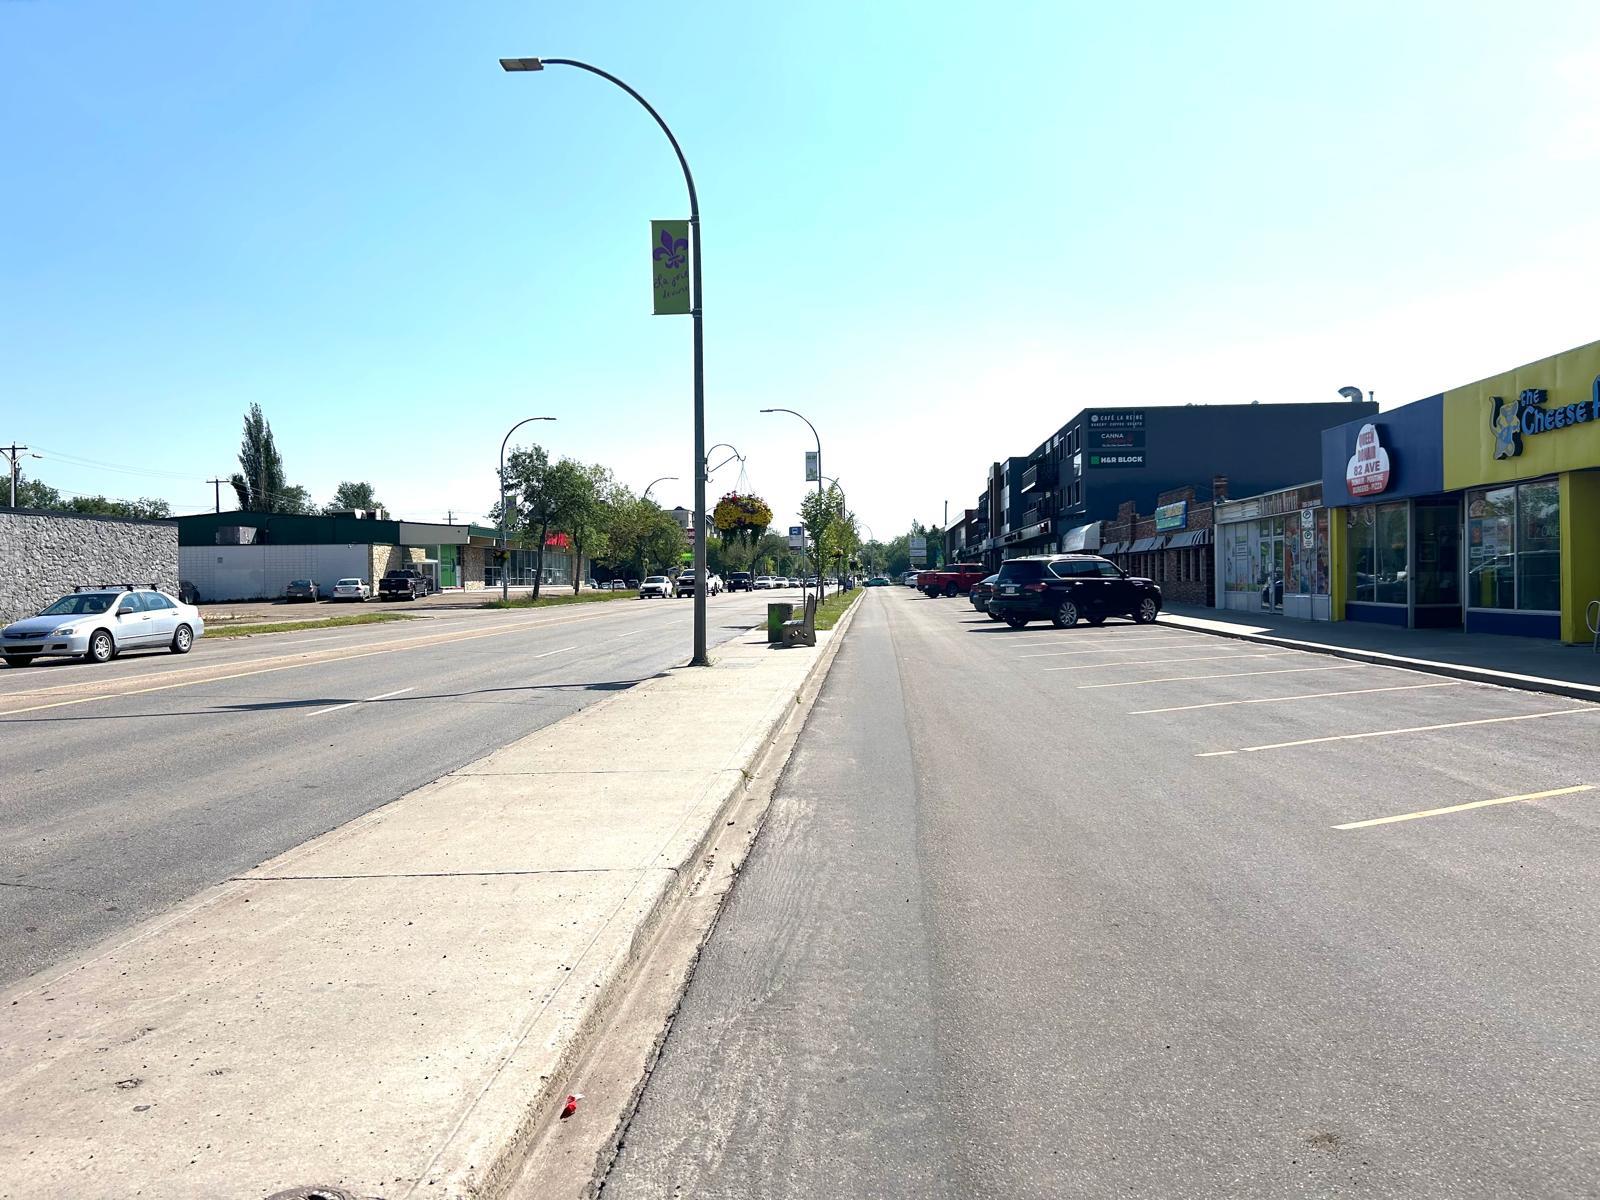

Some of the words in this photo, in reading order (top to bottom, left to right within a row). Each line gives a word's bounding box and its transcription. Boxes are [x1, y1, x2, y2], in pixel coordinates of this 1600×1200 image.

[1520, 389, 1540, 407] the
[1521, 401, 1588, 436] Cheese
[1100, 456, 1117, 464] H&R
[1353, 464, 1363, 476] 82
[1364, 461, 1380, 474] AVE
